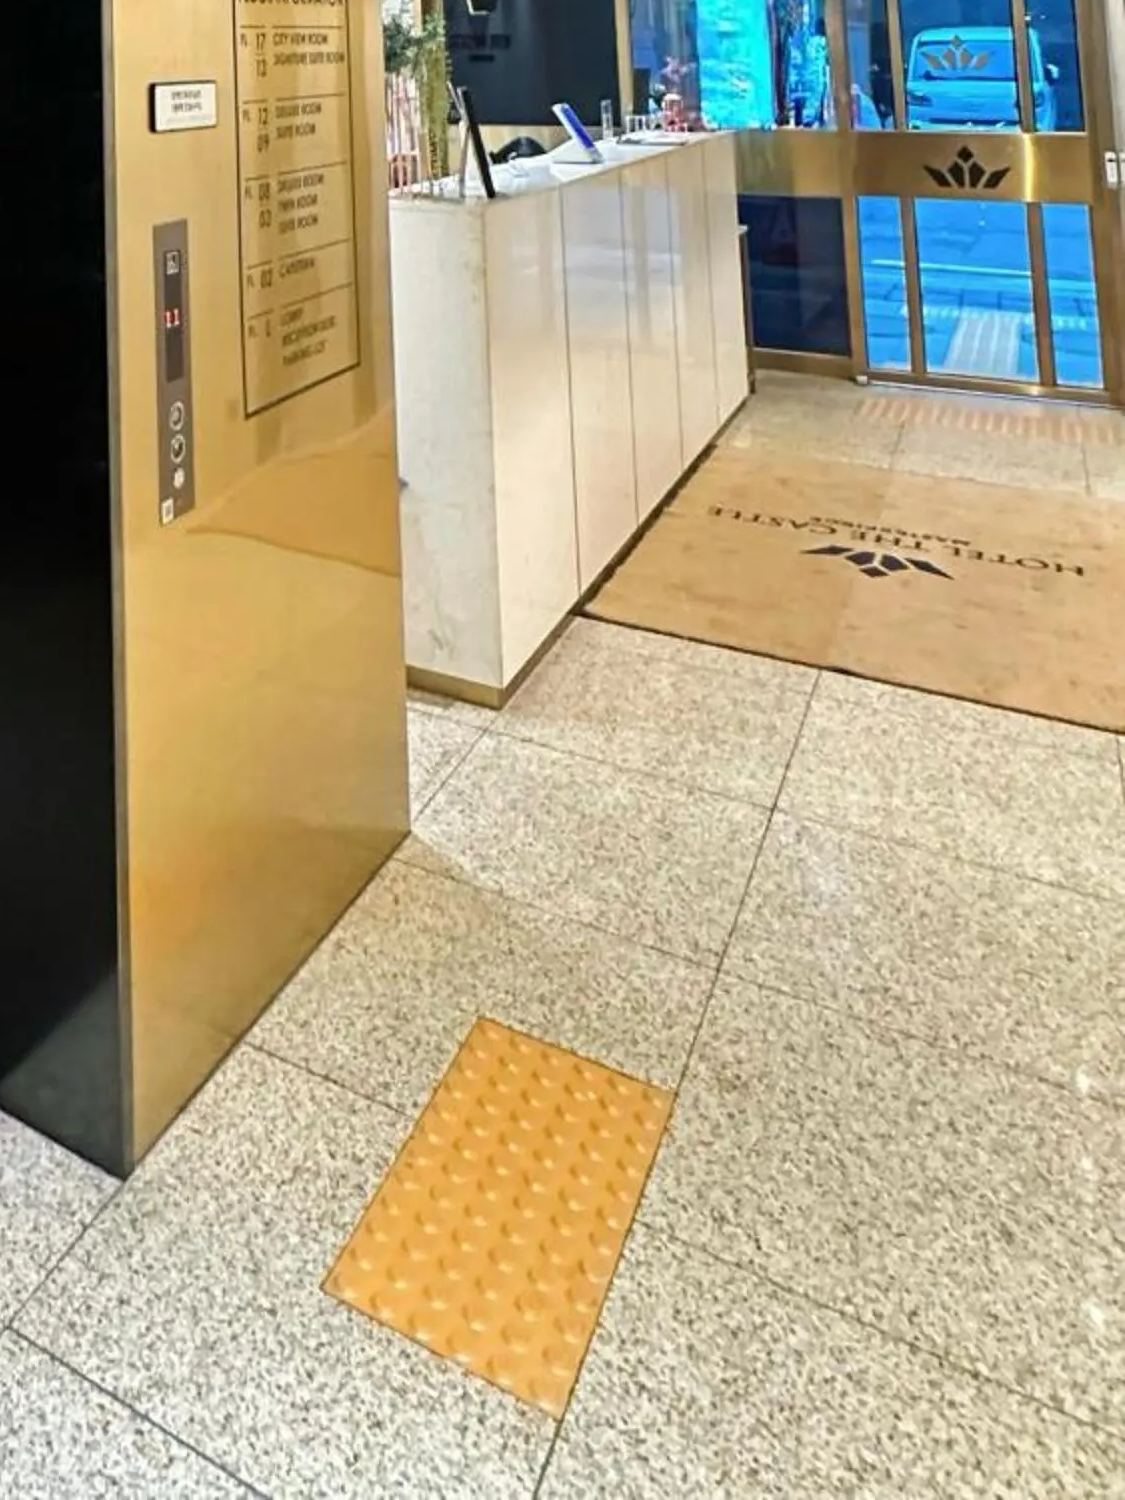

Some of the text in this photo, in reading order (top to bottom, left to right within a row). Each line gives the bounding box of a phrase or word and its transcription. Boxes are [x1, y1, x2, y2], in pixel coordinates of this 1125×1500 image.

[256, 32, 267, 51] 17
[272, 32, 288, 46] CITY
[308, 33, 328, 45] ROOM
[944, 545, 1085, 578] HOTEL
